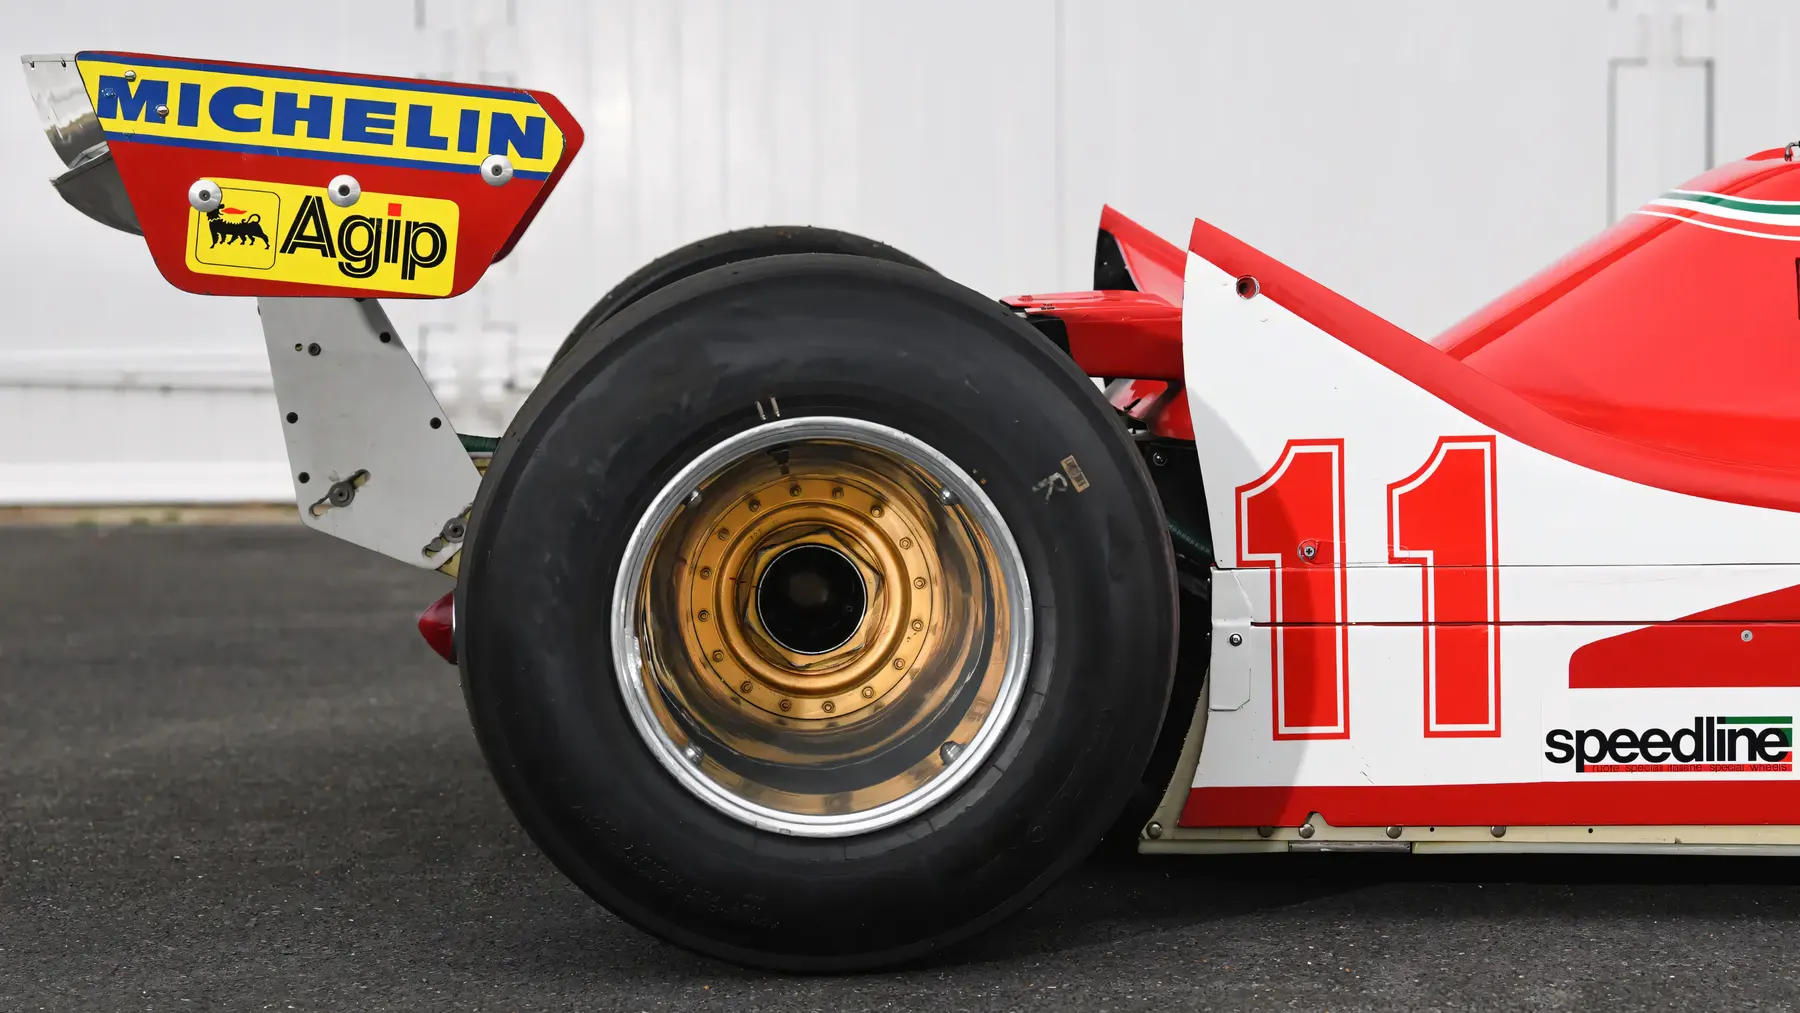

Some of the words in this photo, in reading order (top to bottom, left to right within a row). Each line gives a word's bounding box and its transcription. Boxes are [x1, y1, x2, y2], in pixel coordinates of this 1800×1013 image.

[98, 74, 547, 160] MICHELIN
[279, 195, 448, 281] Agip
[1235, 434, 1502, 741] 11
[1545, 716, 1790, 773] speedline
[1709, 763, 1745, 774] special
[1749, 763, 1788, 773] wheels
